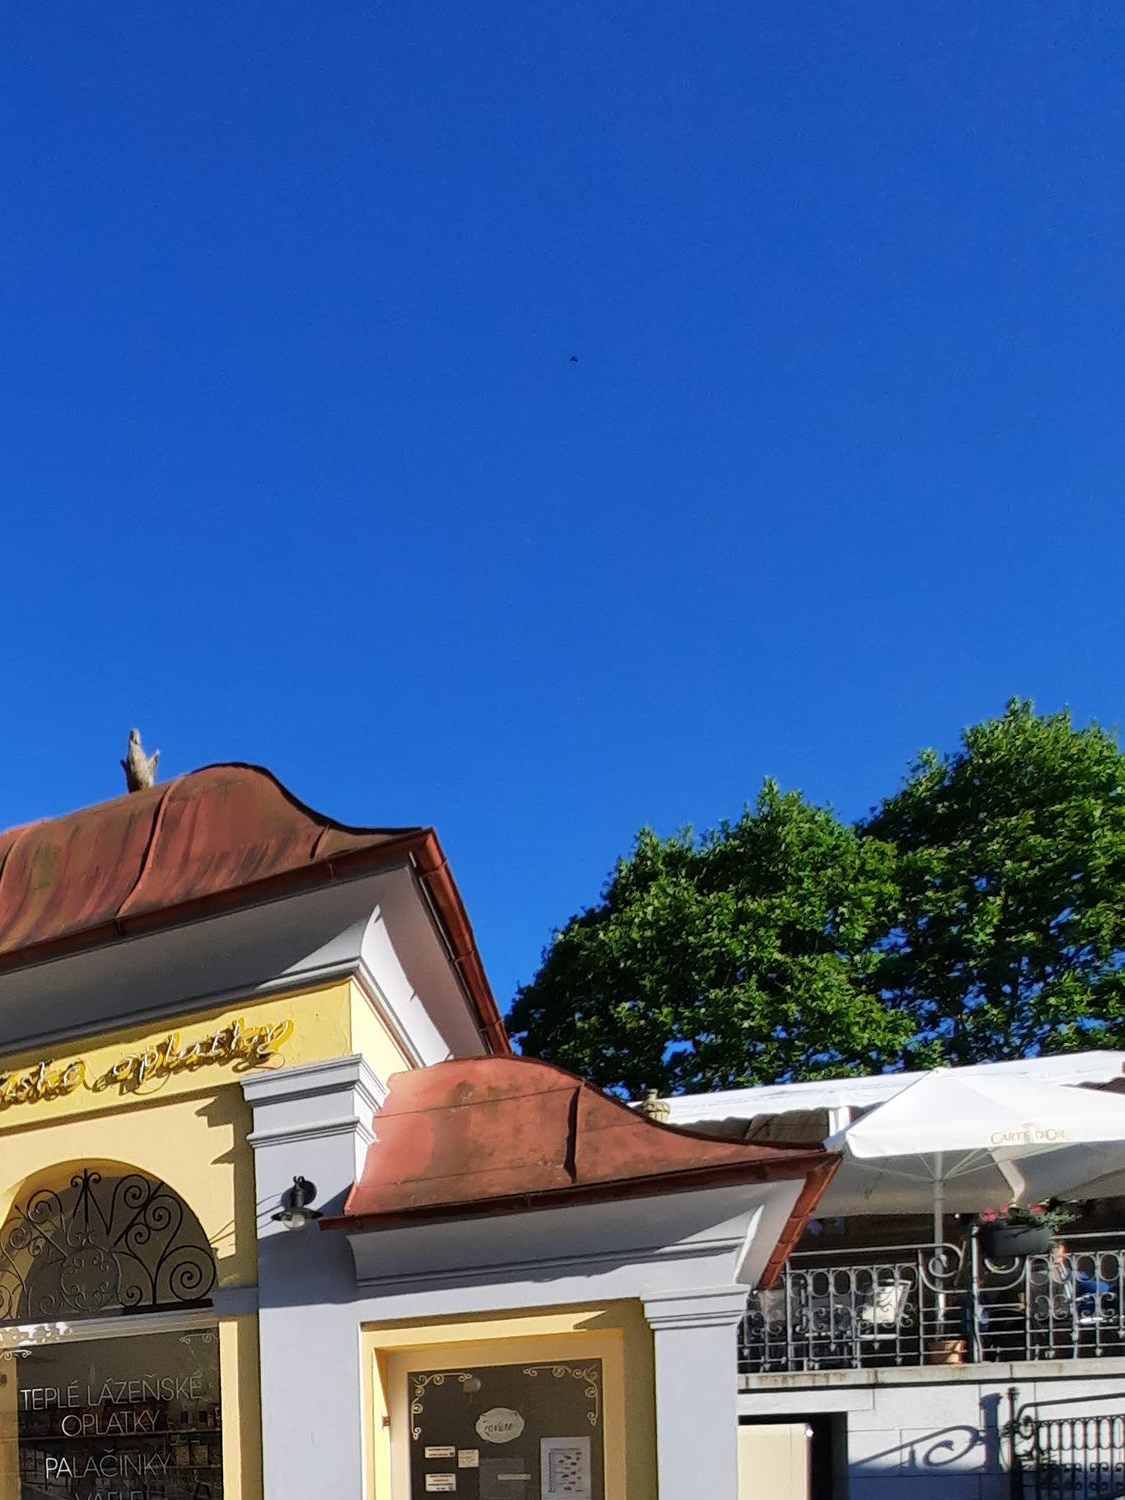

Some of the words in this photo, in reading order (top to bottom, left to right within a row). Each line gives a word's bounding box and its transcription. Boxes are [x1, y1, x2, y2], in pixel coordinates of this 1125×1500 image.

[19, 1379, 80, 1411] TEPLÉ
[87, 1370, 204, 1406] LÁZEŇSKÉ
[61, 1409, 161, 1437] OPLATKY
[45, 1448, 172, 1480] PALAČINKY
